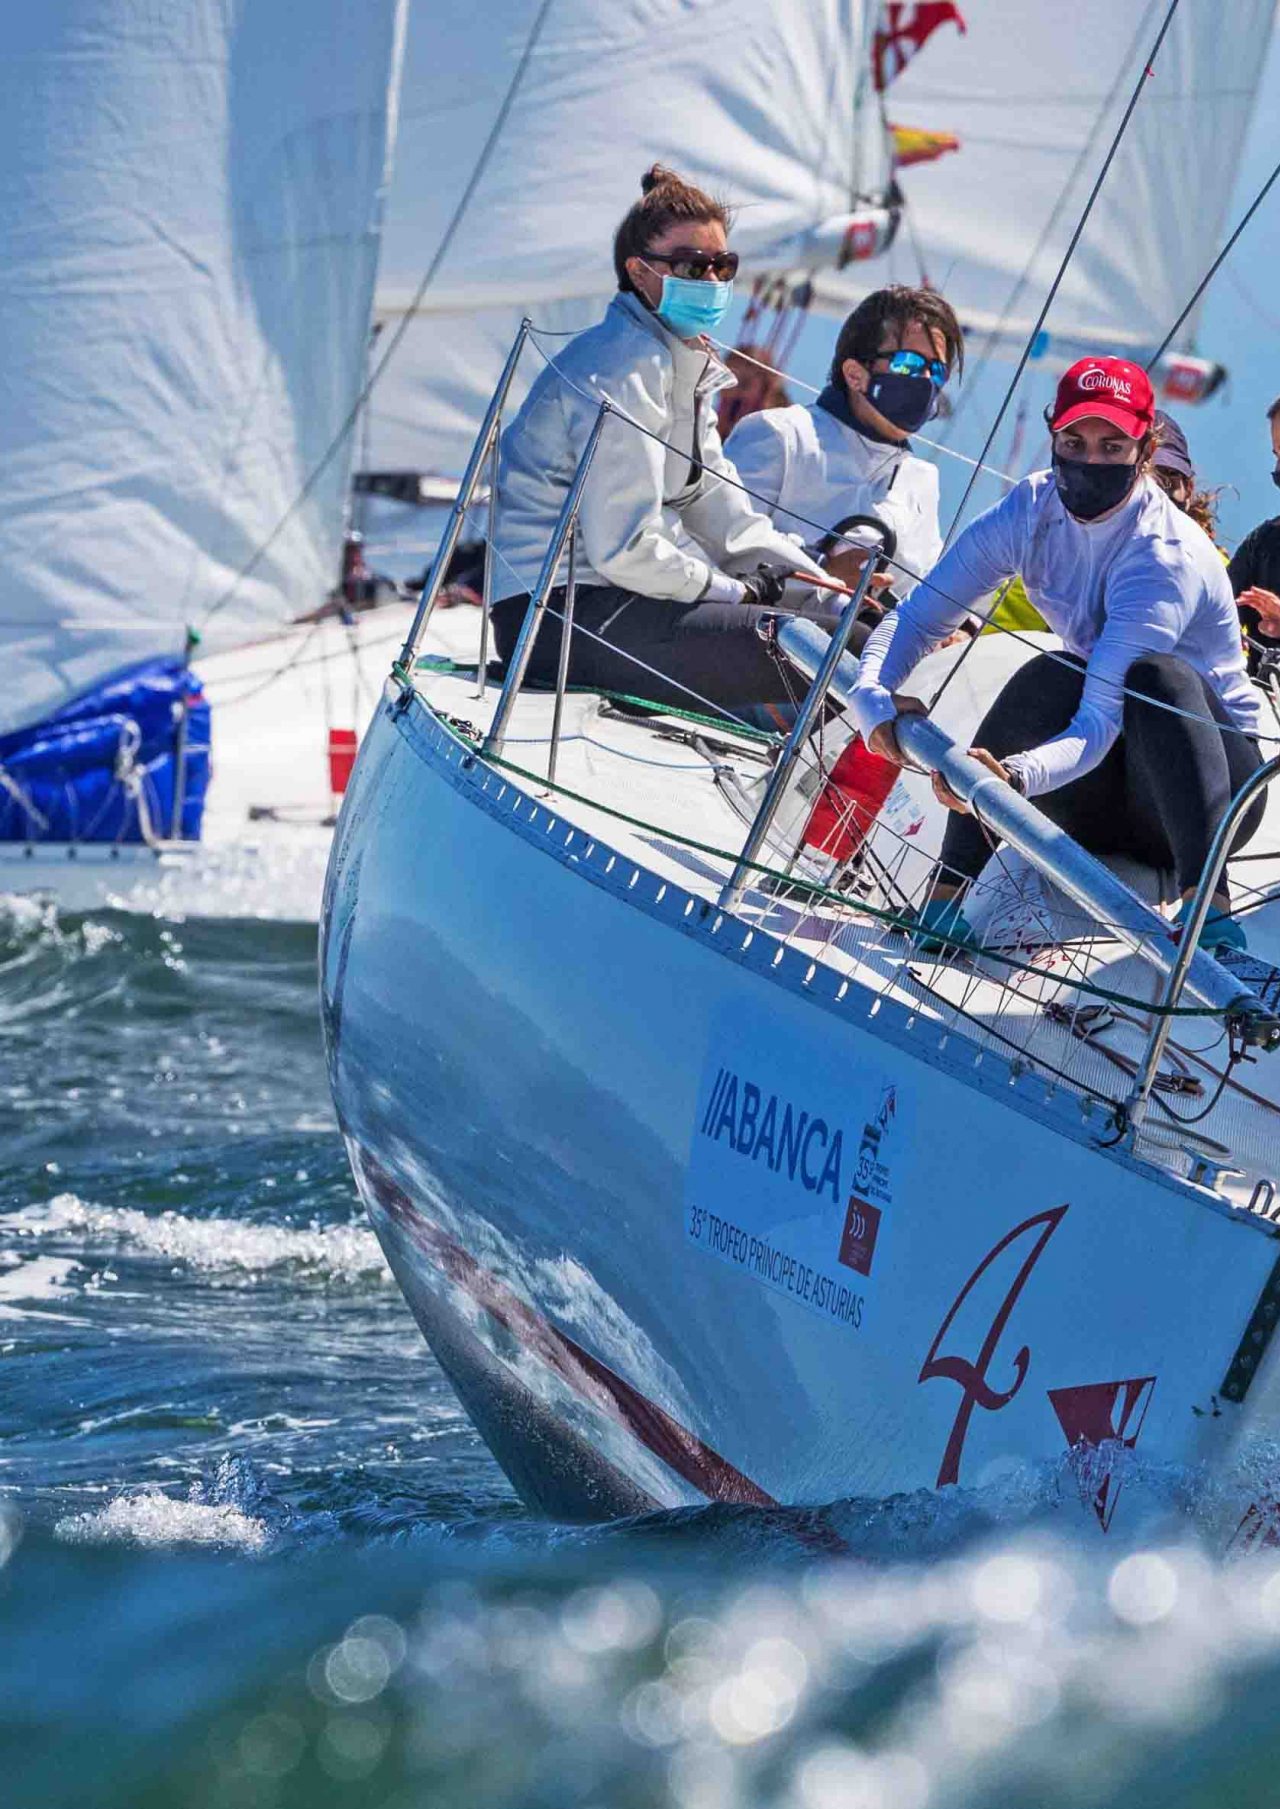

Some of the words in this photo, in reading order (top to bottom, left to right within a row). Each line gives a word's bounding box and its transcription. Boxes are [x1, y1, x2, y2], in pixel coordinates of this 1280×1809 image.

[709, 1214, 748, 1264] TROFEO
[796, 1264, 812, 1300] DE
[811, 1276, 865, 1329] ASTURIAS
